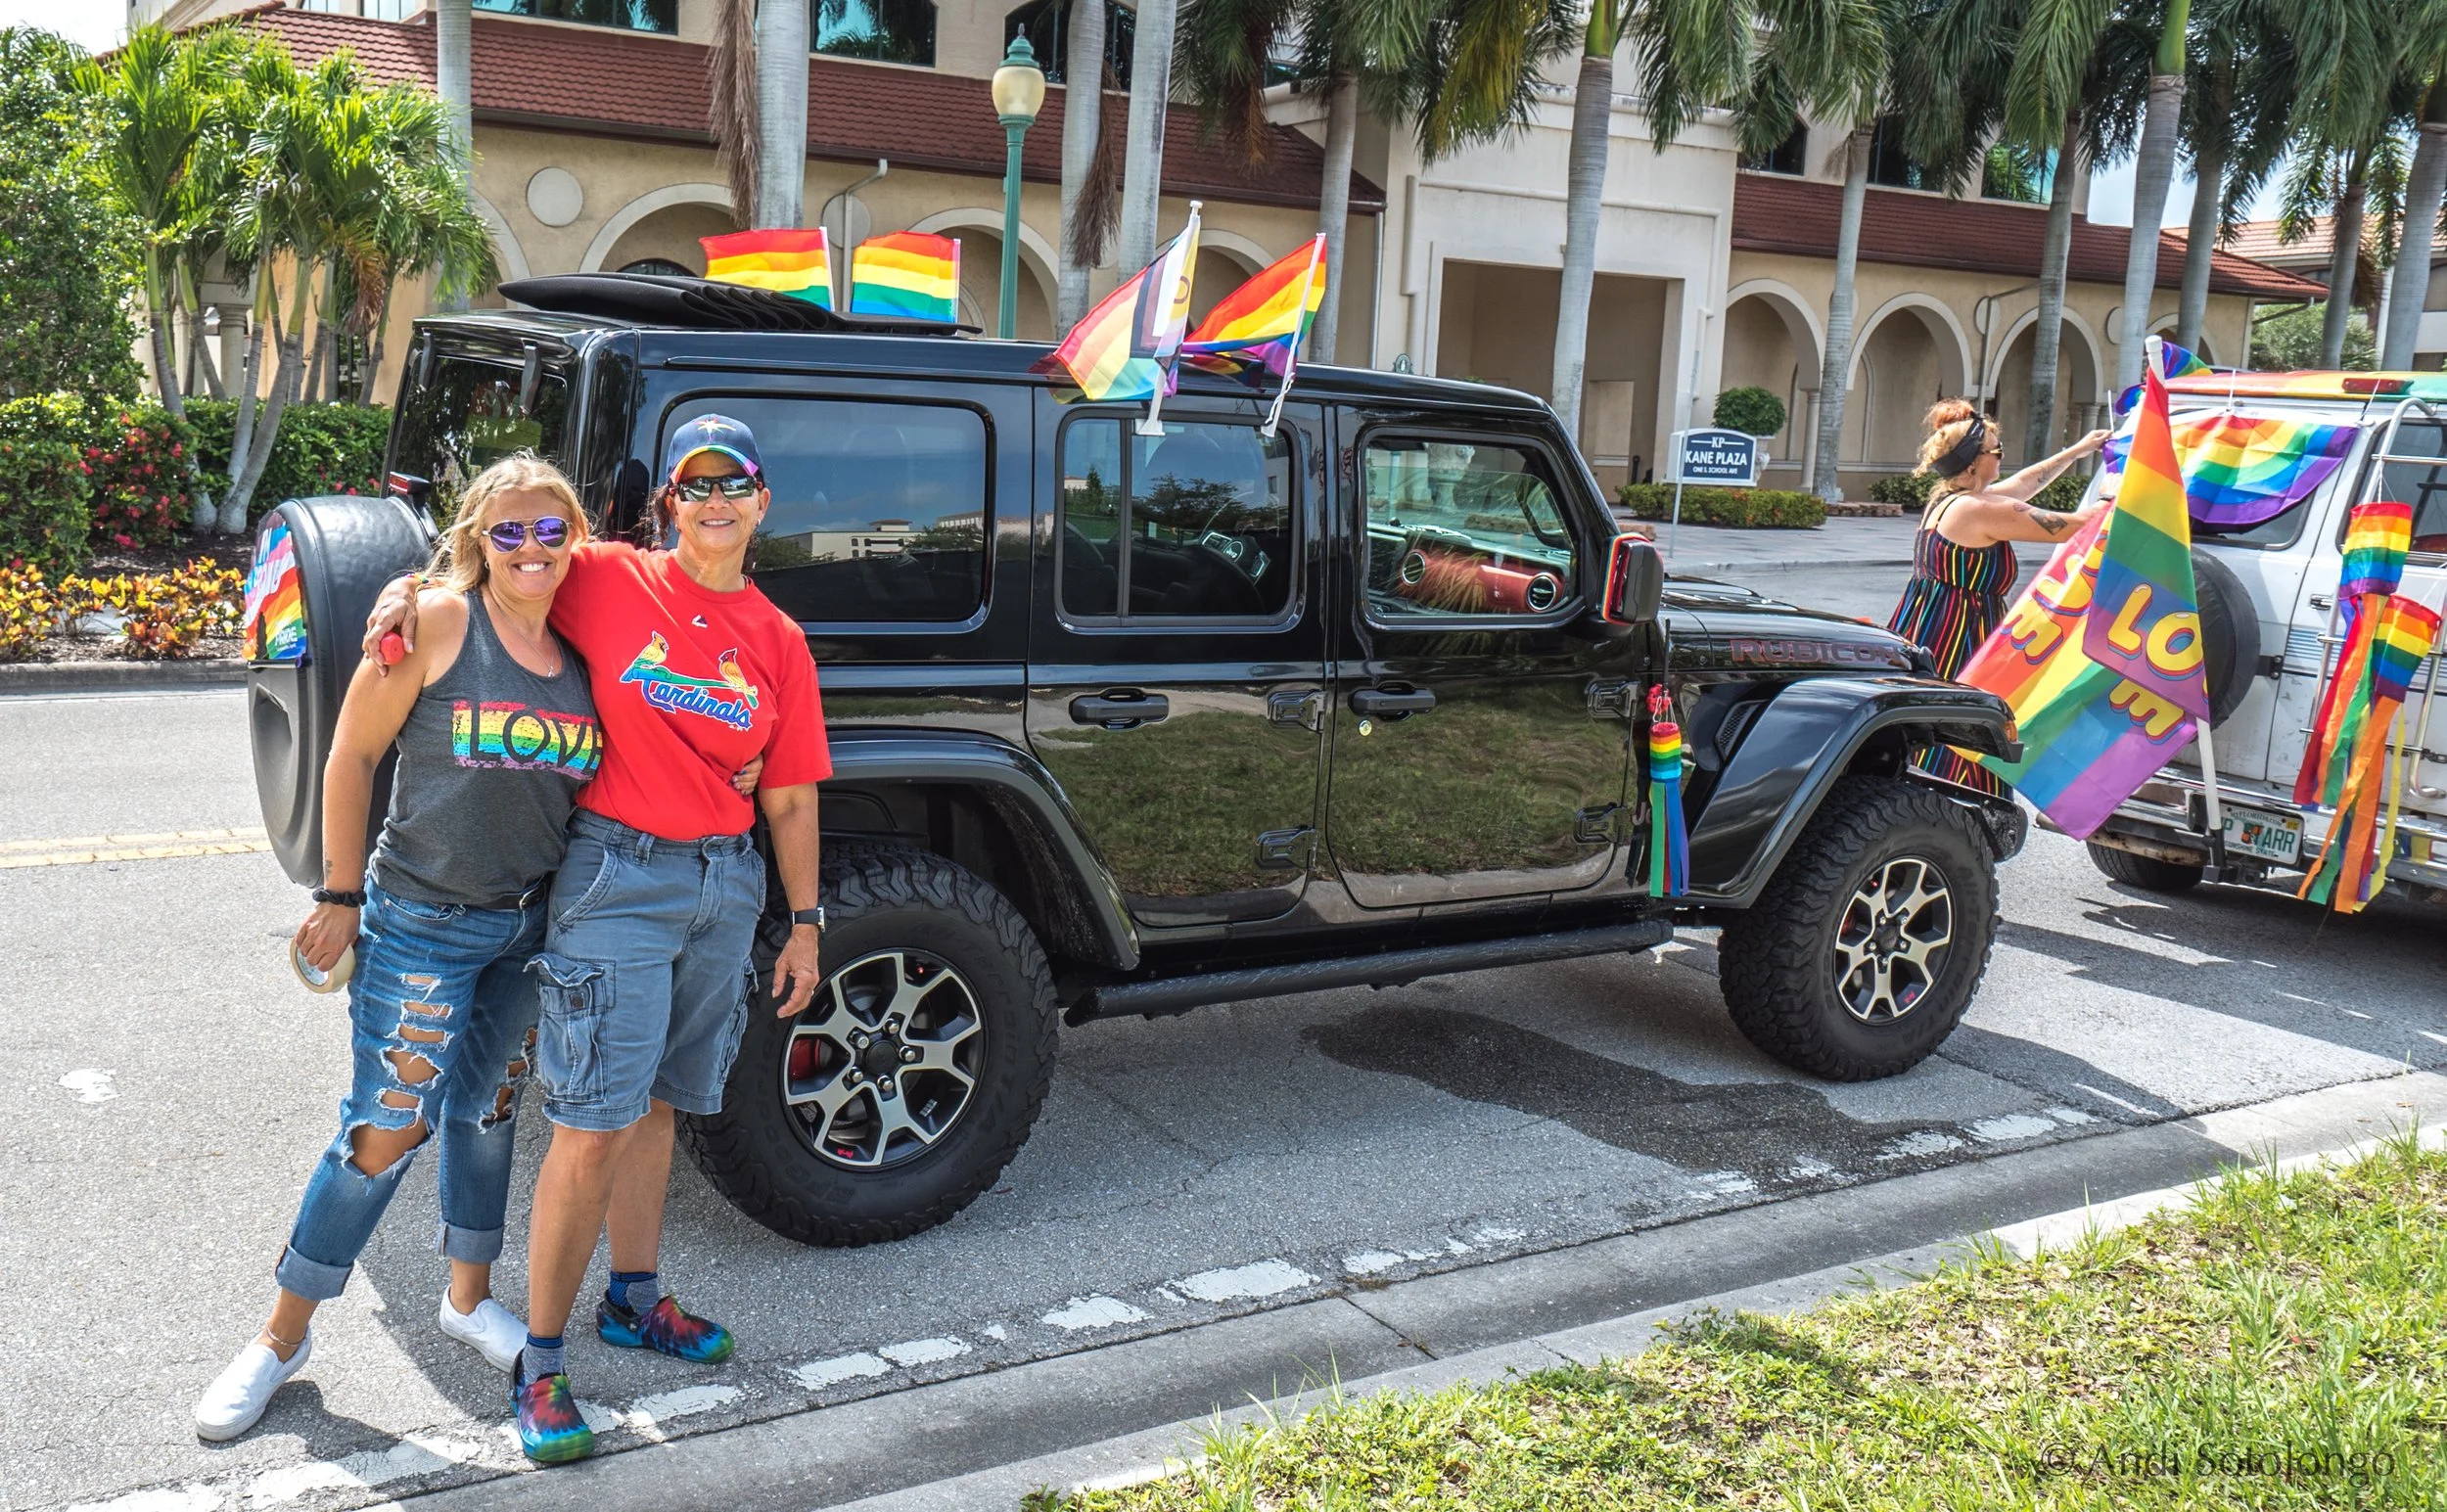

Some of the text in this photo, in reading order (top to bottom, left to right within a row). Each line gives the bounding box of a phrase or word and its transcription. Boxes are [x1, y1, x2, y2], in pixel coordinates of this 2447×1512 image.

[1711, 436, 1726, 448] KP
[1685, 450, 1747, 466] KANE PLAZA
[1730, 639, 1906, 664] RUBICON
[641, 679, 754, 729] Cardinals
